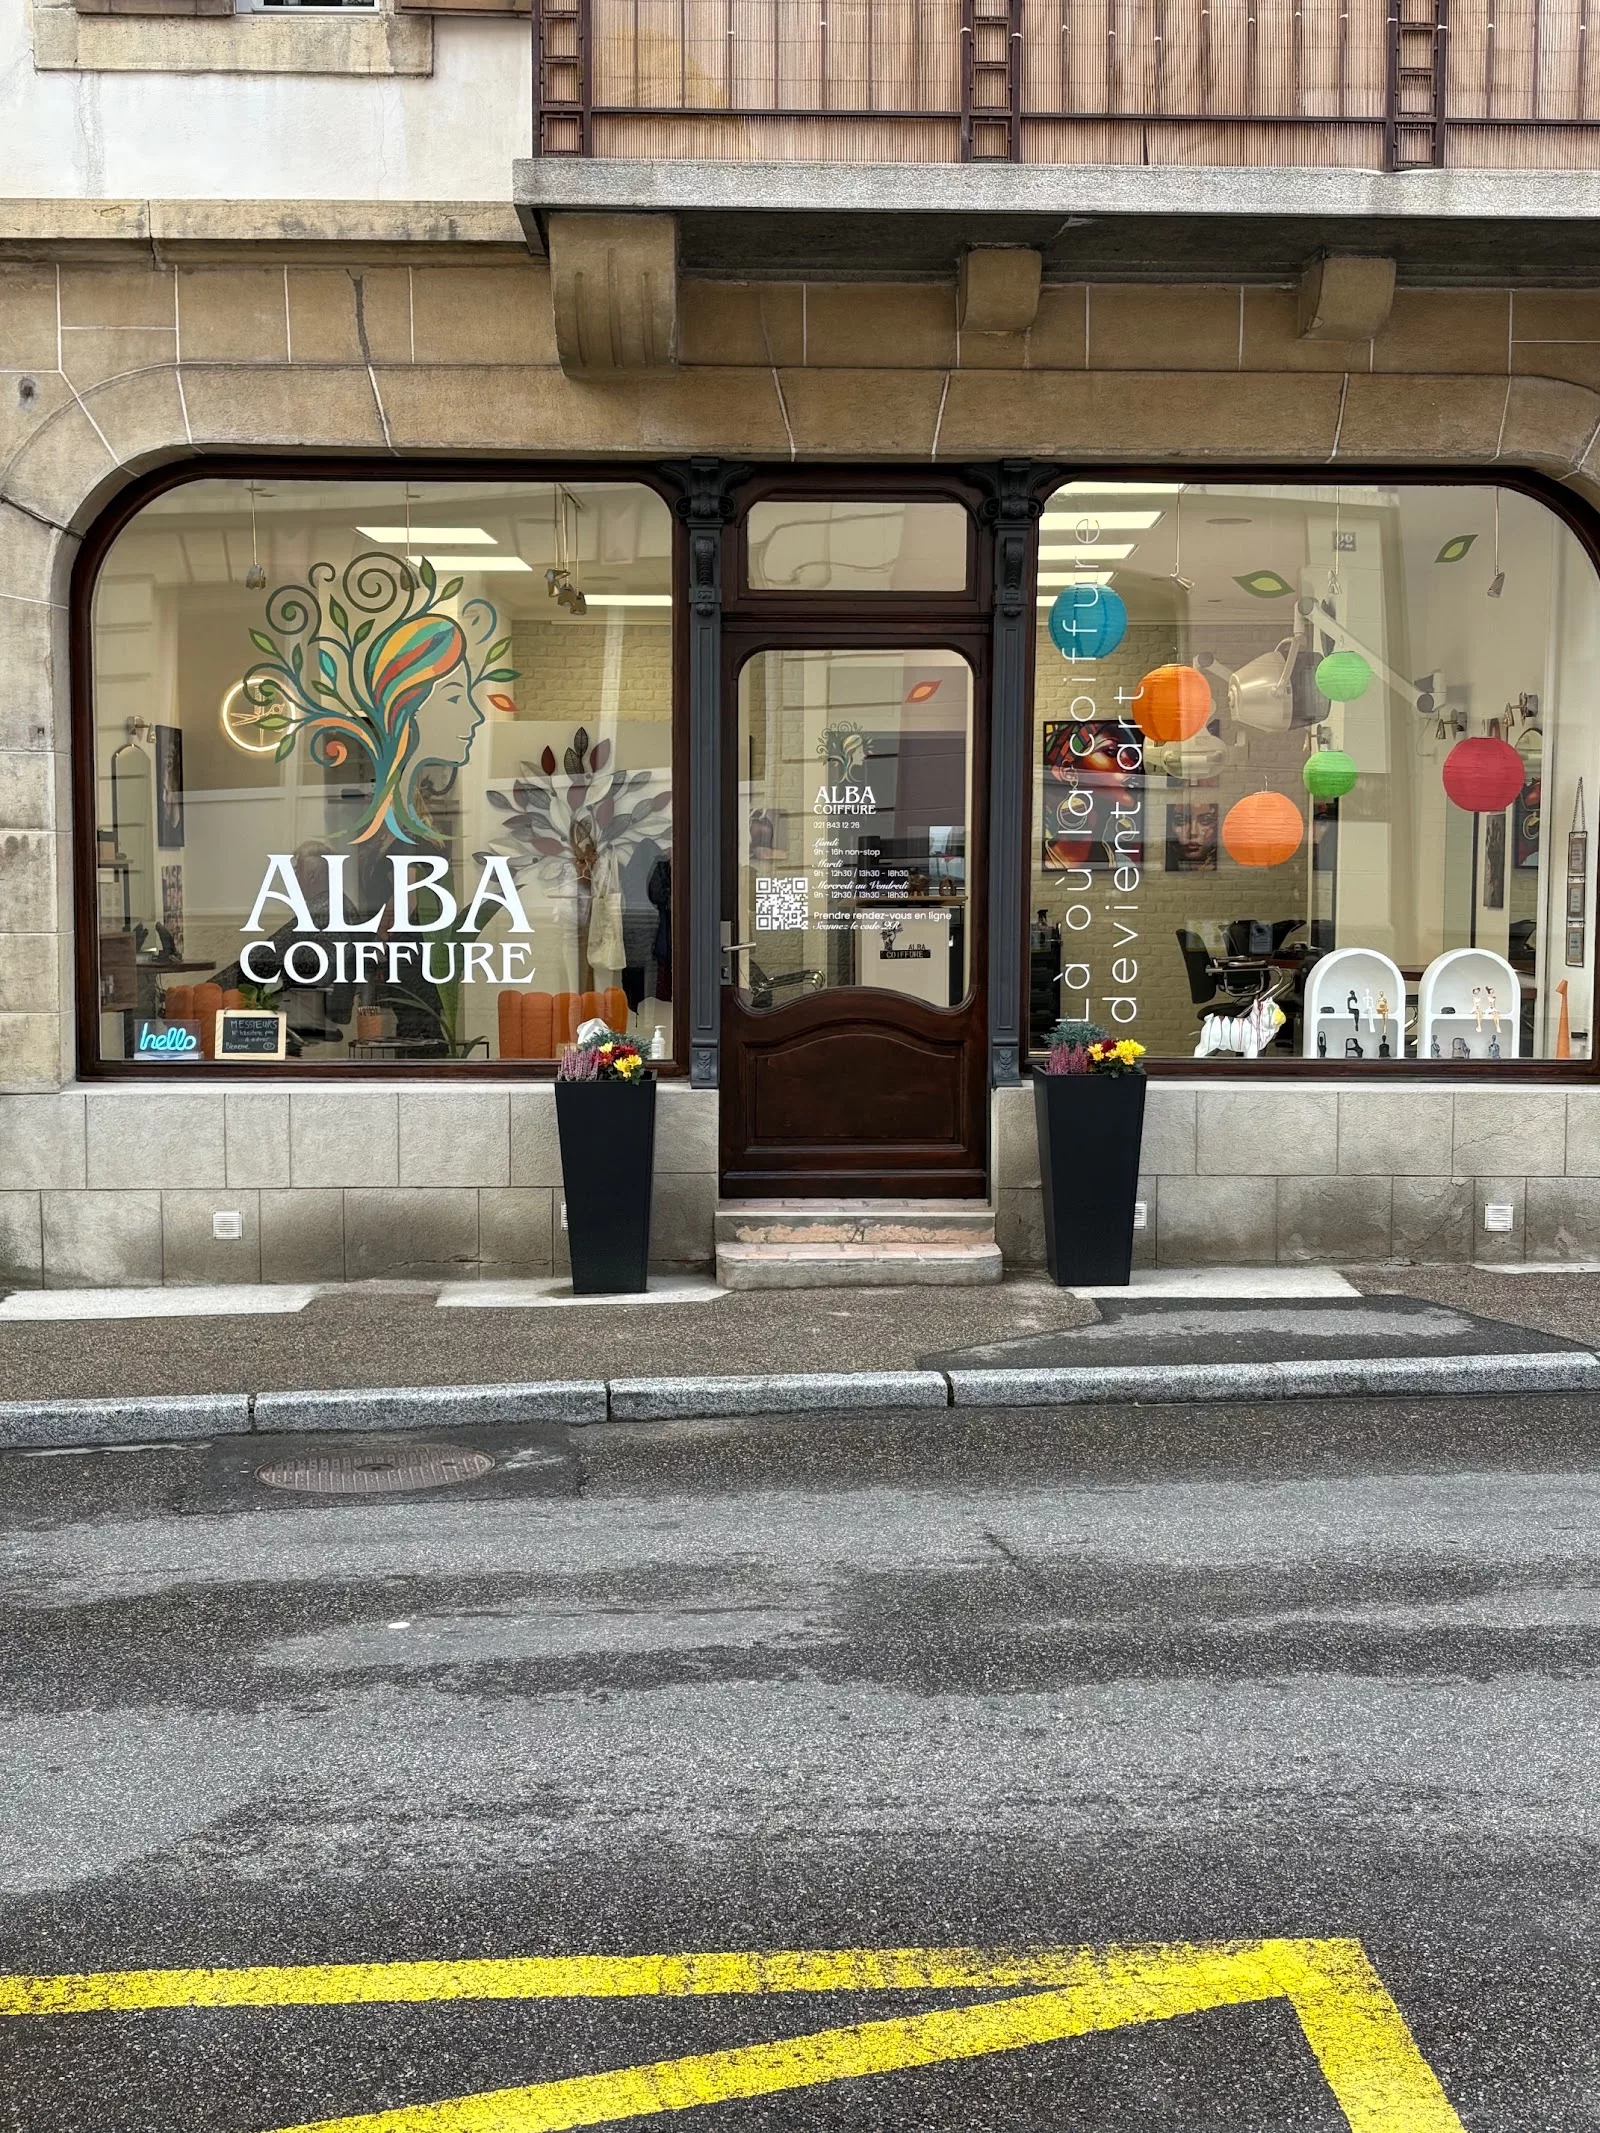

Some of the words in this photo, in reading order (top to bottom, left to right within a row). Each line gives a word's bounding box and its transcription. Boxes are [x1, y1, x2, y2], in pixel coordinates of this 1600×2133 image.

[1061, 518, 1101, 757] coiffure
[1113, 686, 1145, 771] art
[814, 785, 876, 804] ALBA
[813, 804, 876, 815] COIFFURE
[1058, 790, 1094, 834] la
[813, 821, 825, 829] 021
[826, 821, 840, 829] 843
[842, 821, 849, 829] 12
[811, 837, 839, 848] Lundi
[813, 848, 823, 856] 9h
[845, 848, 880, 857] non-stop
[811, 859, 844, 868] Mardi
[811, 880, 854, 890] Mercredi
[869, 880, 909, 890] Vendredi
[239, 854, 536, 934] ALBA
[813, 891, 824, 899] 9h
[831, 891, 852, 899] 12h30
[859, 891, 880, 899] 13h30
[887, 891, 909, 899] 18h30
[1055, 868, 1092, 931] où
[813, 911, 850, 920] Prendre
[853, 911, 912, 920] rendez-vous
[914, 912, 927, 920] en
[928, 911, 952, 922] ligne
[1102, 801, 1142, 1023] devient
[812, 921, 849, 930] Scannez
[850, 921, 859, 930] le
[860, 921, 880, 930] code
[239, 941, 537, 985] COIFFURE
[1053, 963, 1090, 1023] Là
[230, 1020, 278, 1029] MESSIEURS
[140, 1022, 196, 1051] hello
